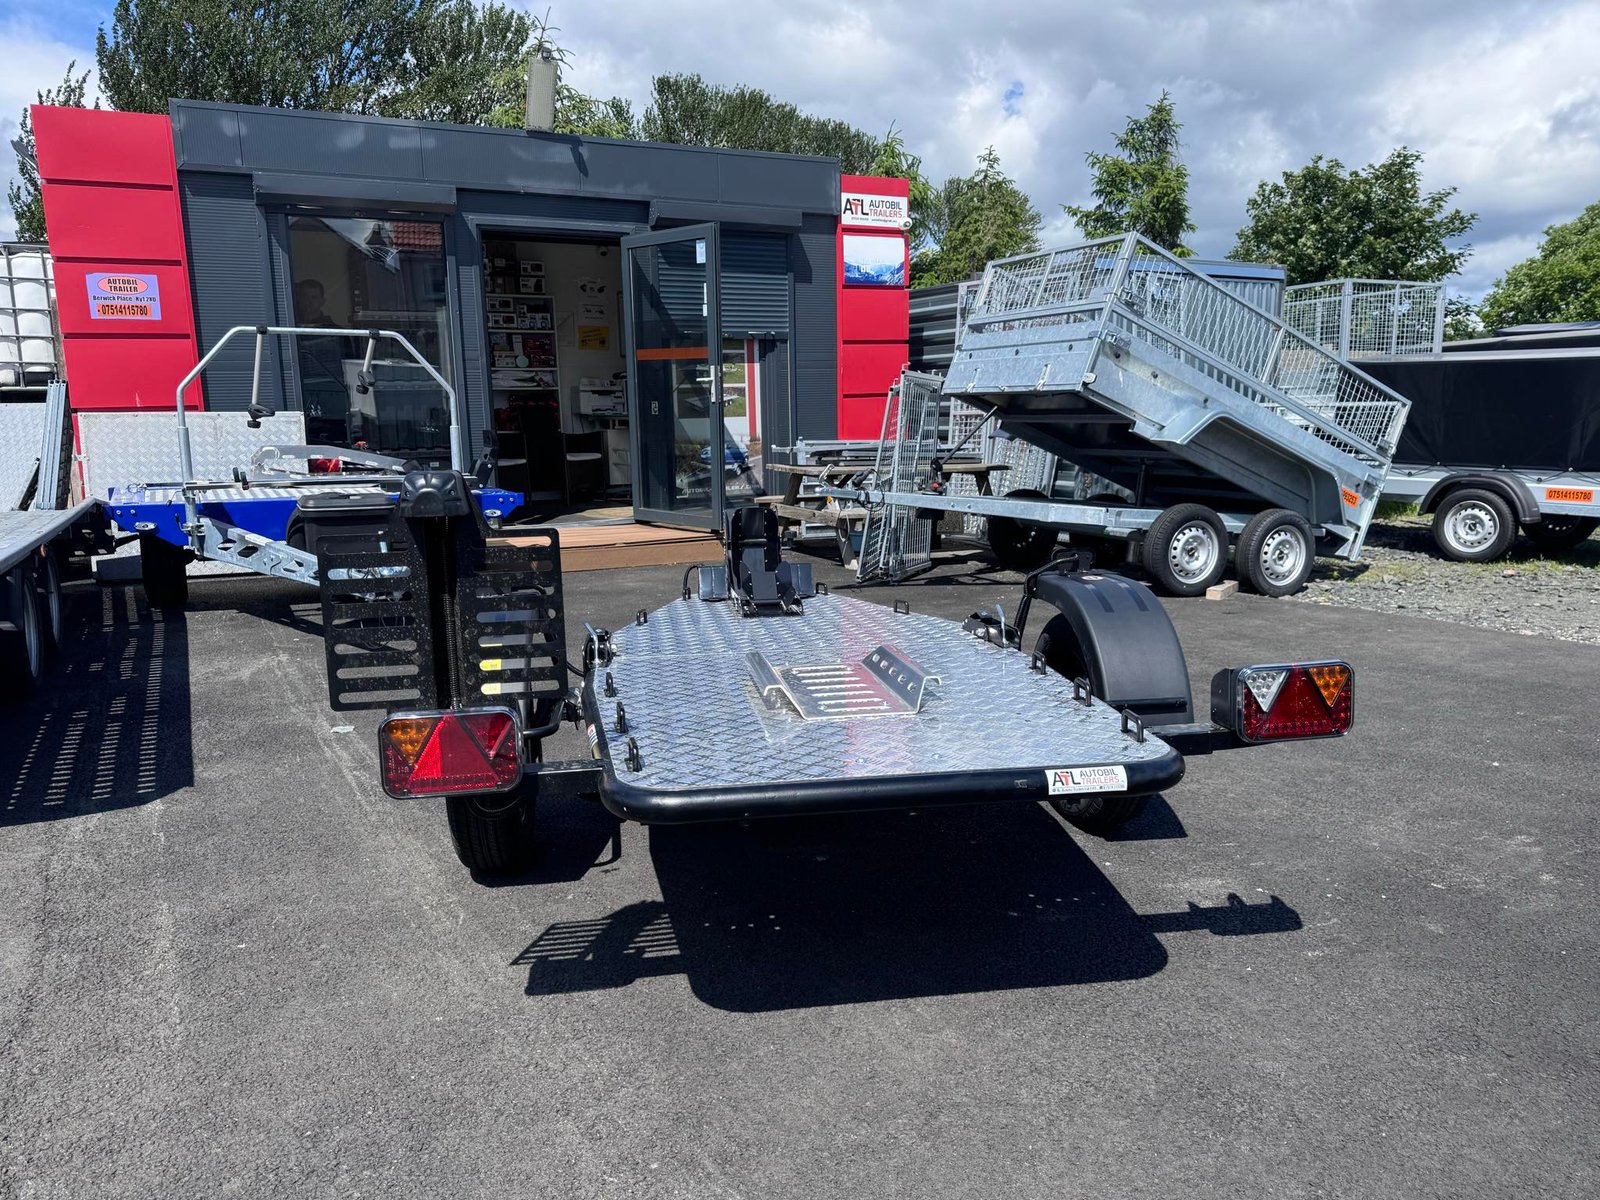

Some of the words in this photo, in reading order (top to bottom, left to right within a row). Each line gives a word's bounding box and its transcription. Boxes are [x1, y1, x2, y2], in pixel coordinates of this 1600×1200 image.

[843, 198, 869, 215] ATL
[869, 200, 902, 210] AUTOBIL
[869, 209, 902, 218] TRAILERS
[107, 278, 138, 286] AUTOBIL
[101, 304, 148, 316] 07514115780
[1548, 490, 1592, 500] 07514115780
[1080, 768, 1118, 778] AUTOBIL
[1052, 771, 1081, 786] ATL
[1082, 776, 1120, 785] TRAILERS
